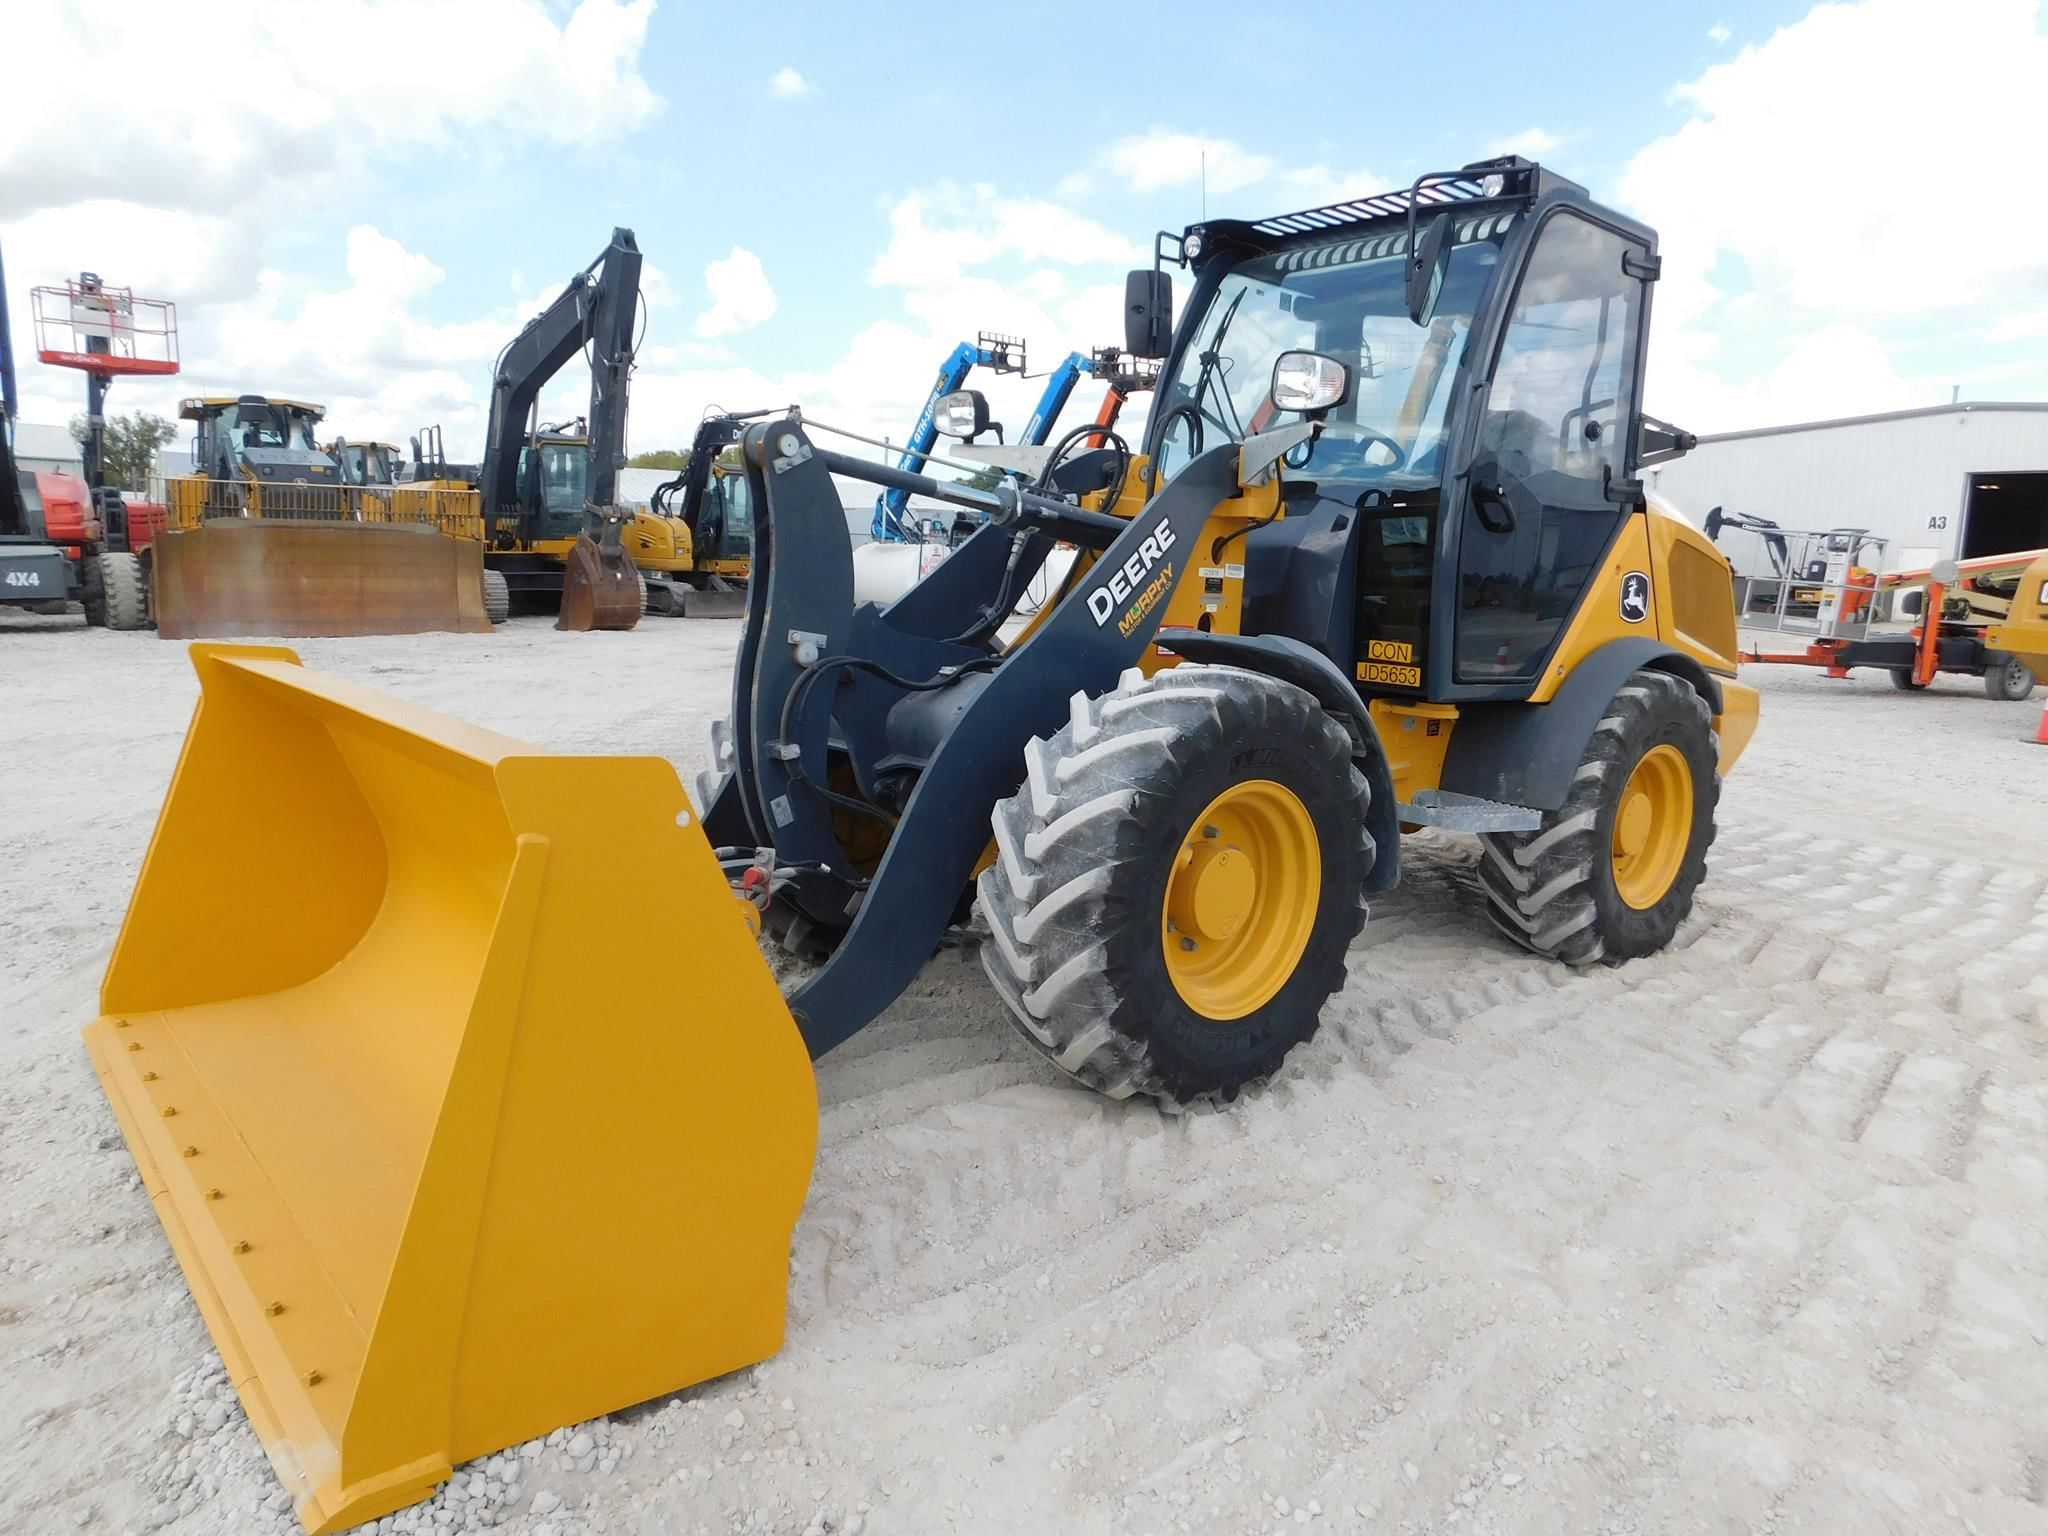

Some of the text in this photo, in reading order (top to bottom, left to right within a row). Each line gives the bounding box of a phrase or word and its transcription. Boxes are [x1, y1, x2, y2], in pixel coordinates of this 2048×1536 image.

[1928, 516, 1947, 530] A3
[1086, 517, 1176, 627] DEERE
[1118, 562, 1173, 635] MURPHY
[1371, 642, 1409, 662] CON
[1359, 664, 1417, 685] JD5653
